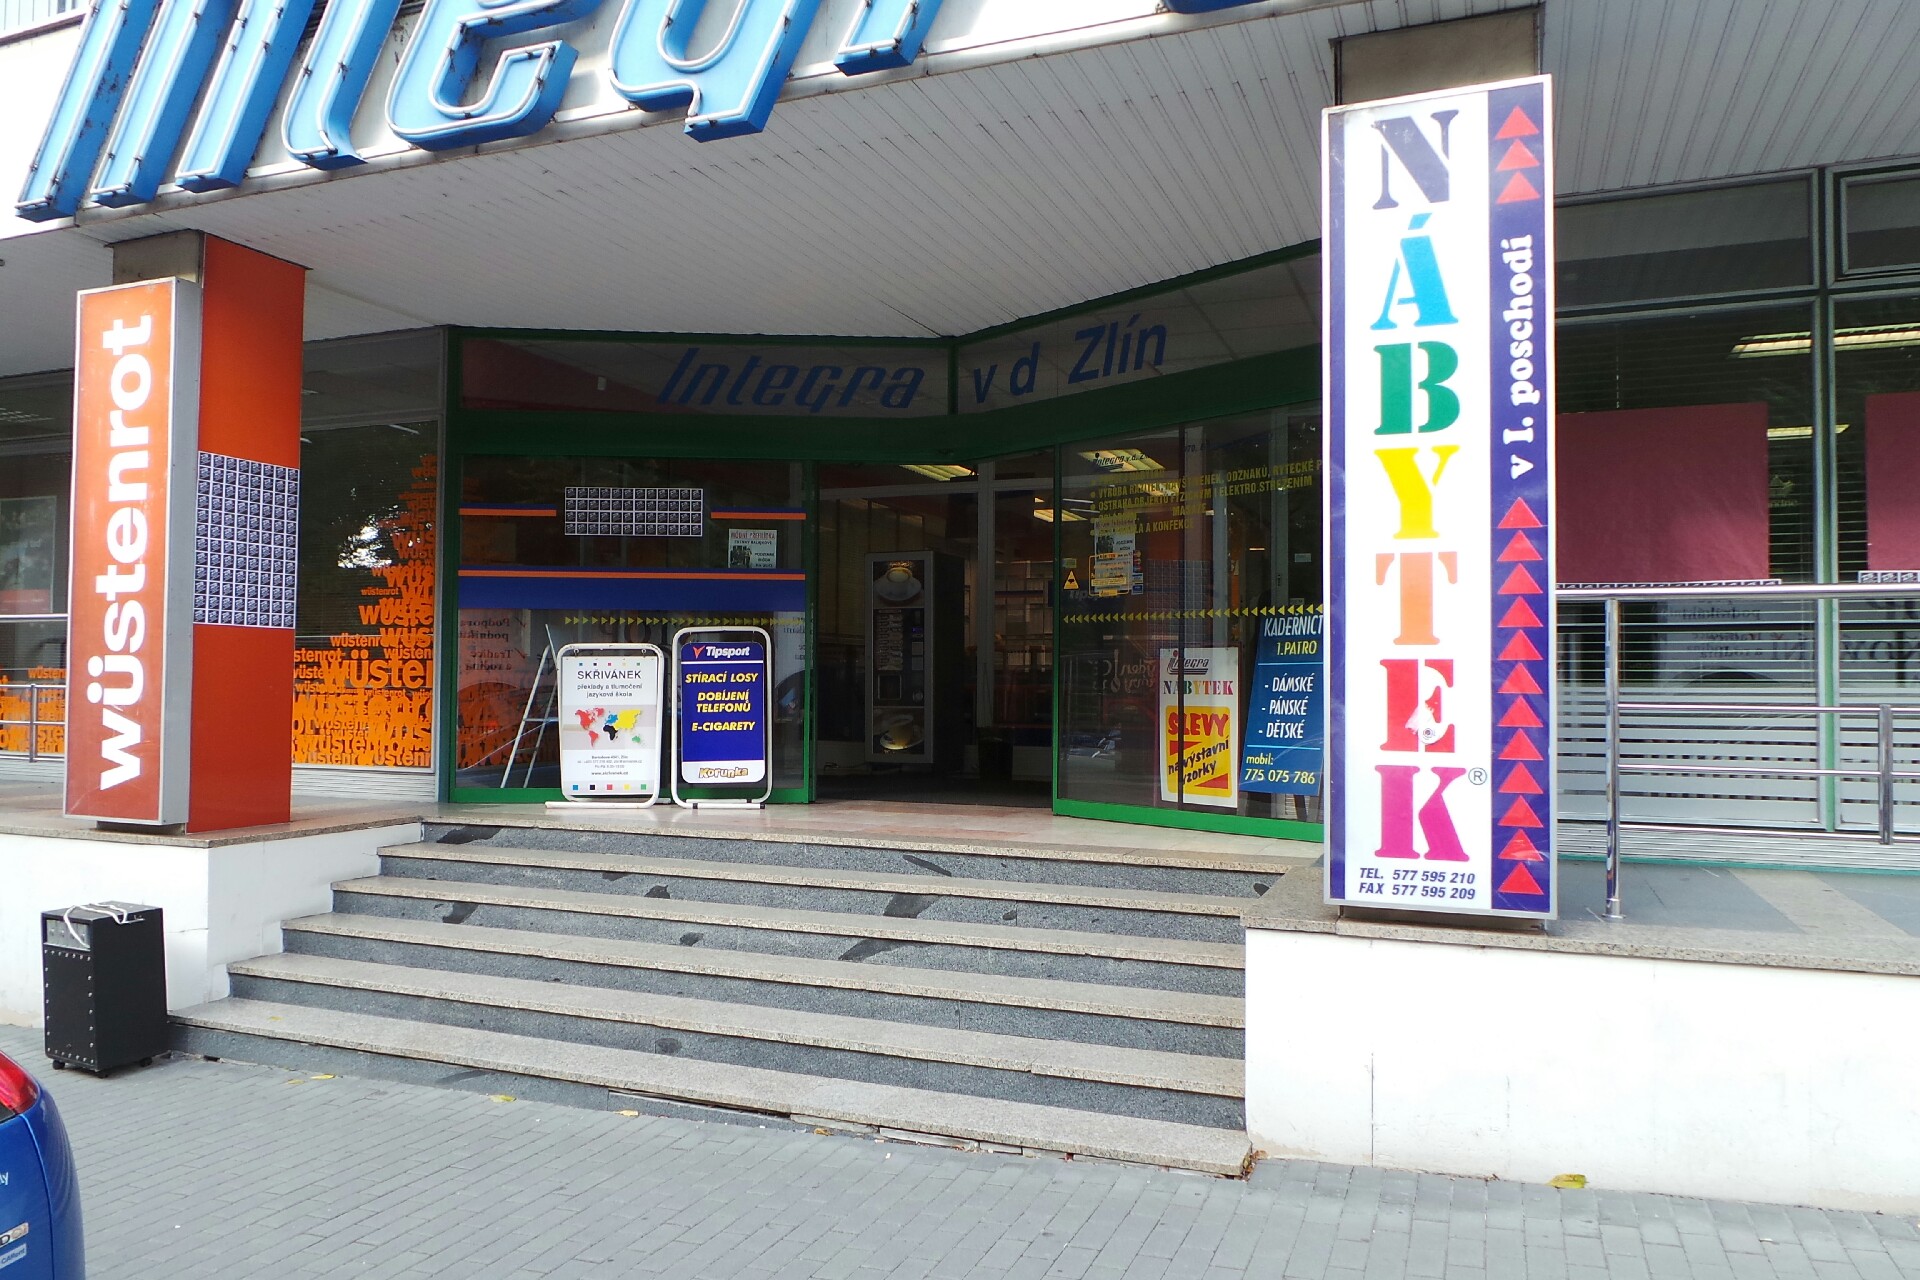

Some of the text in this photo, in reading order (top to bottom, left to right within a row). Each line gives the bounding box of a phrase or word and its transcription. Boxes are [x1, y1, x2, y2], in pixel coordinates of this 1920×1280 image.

[657, 312, 1169, 411] Integra v d Zlín
[1510, 453, 1534, 480] v
[1370, 109, 1470, 863] NÁBYTEK
[86, 314, 153, 790] wüstenrot
[705, 646, 751, 659] Tipsport
[577, 668, 642, 680] SKŘIVÁNEK
[684, 671, 759, 684] STÍRACÍ LOSY
[1271, 673, 1315, 693] DÁMSKÉ
[697, 688, 750, 701] DOBÍJENÍ
[696, 700, 752, 713] TELEFONŮ
[1269, 695, 1309, 716] PÁNSKÉ
[691, 721, 756, 732] E-CIGARETY
[1265, 719, 1306, 739] DĚTSKÉ
[1246, 752, 1274, 766] mobil:
[698, 766, 749, 779] Korunka
[1244, 768, 1316, 785] 775 075 786
[1359, 867, 1476, 885] TEL. 577 595 210
[1358, 882, 1476, 900] FAX 577 595 209
